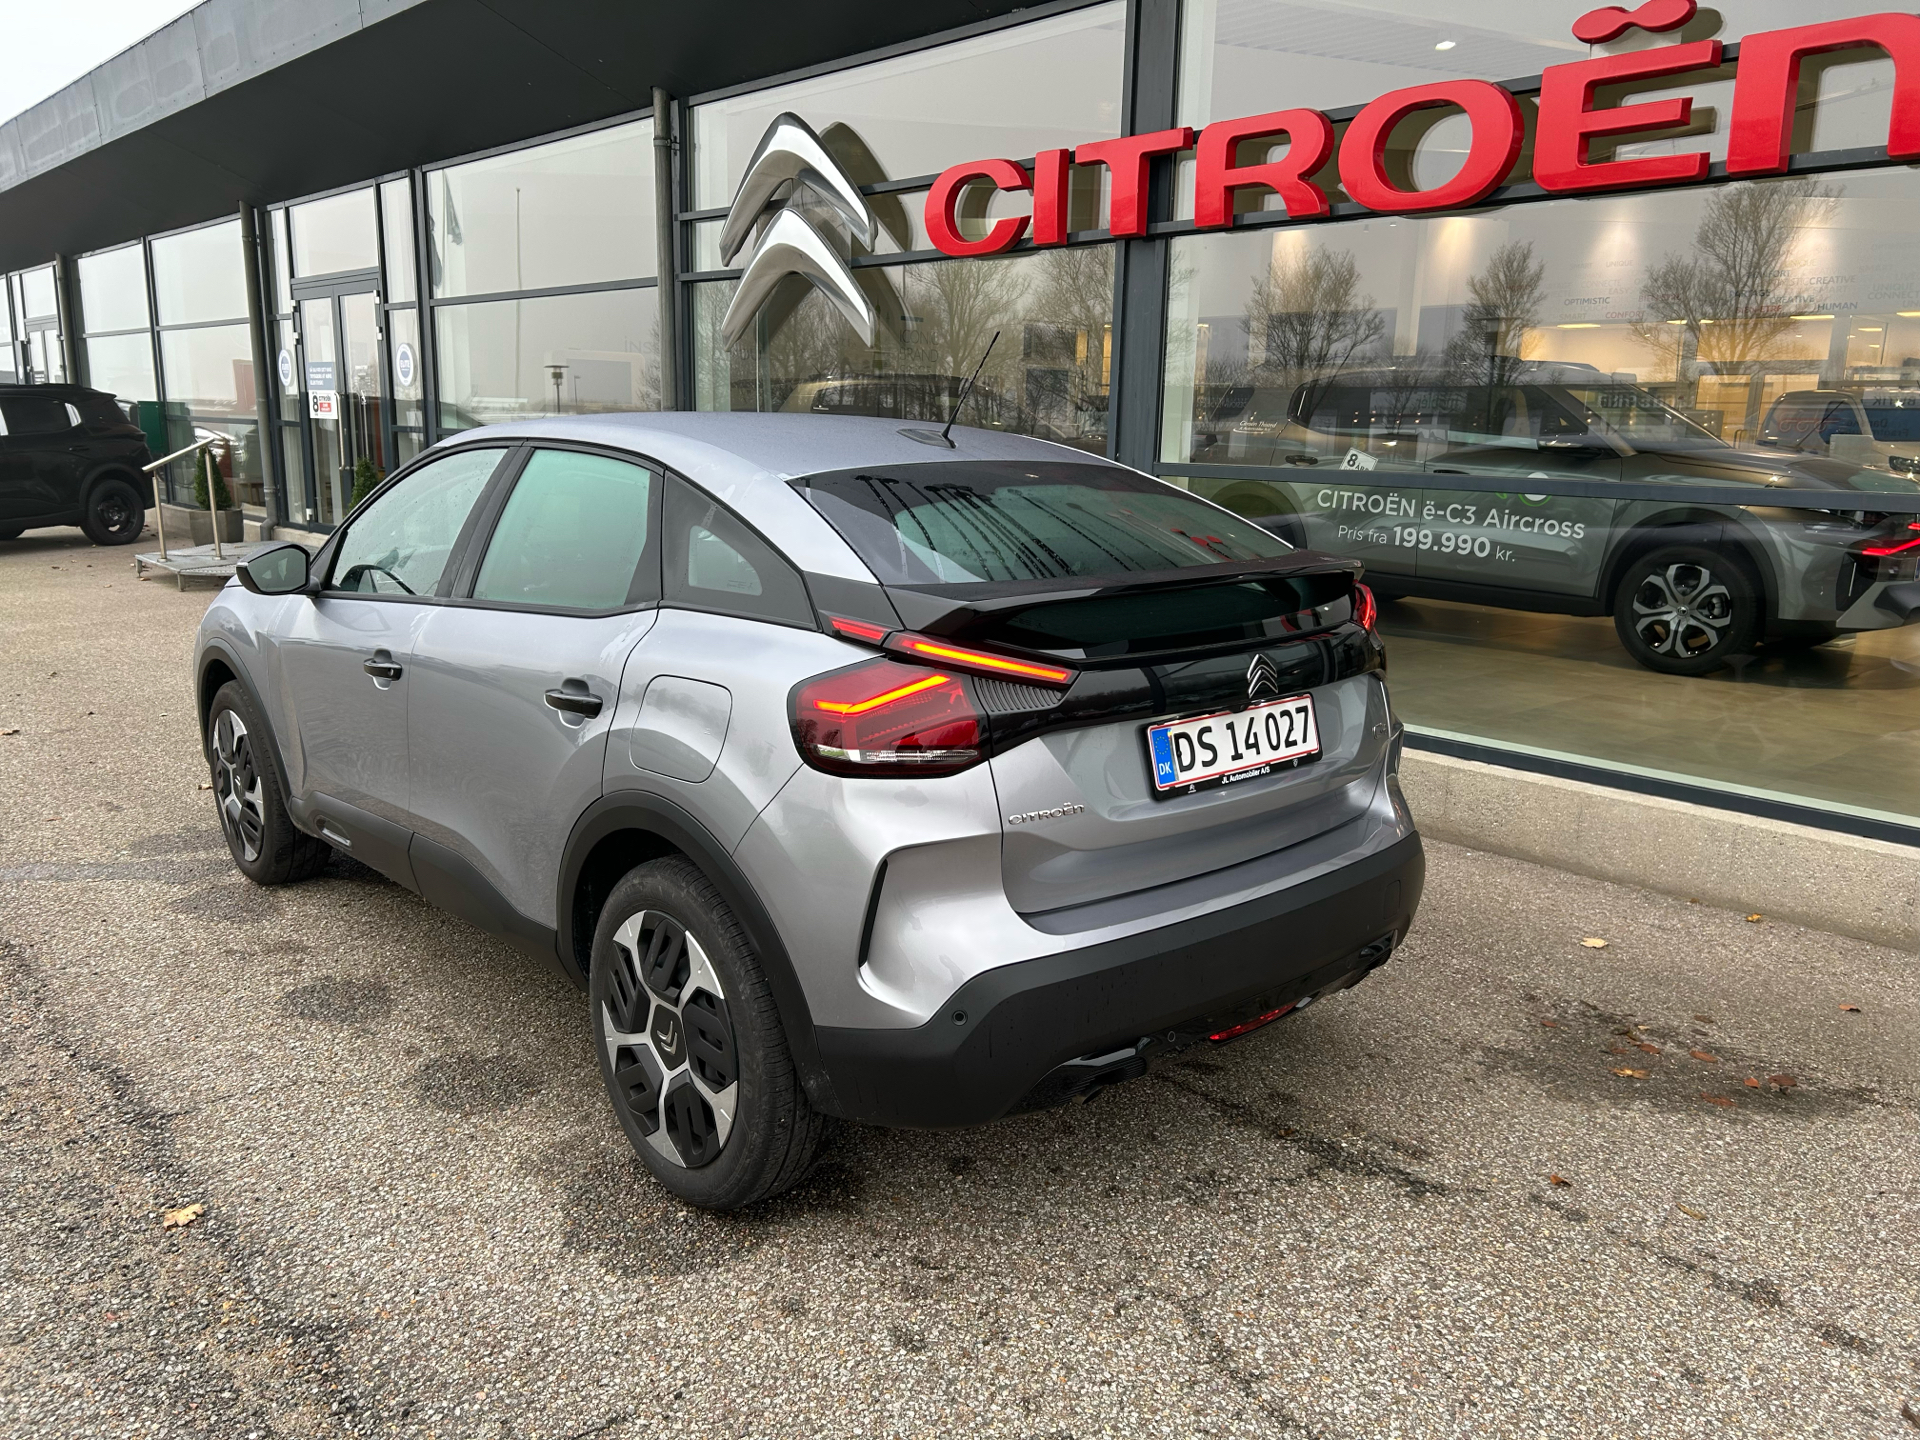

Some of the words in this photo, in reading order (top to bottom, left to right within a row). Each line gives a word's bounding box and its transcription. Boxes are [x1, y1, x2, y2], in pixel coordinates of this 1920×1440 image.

[1605, 260, 1634, 268] UNIQUE
[1809, 275, 1857, 285] CREATIVE
[1872, 282, 1915, 291] UNIQUE
[1563, 296, 1611, 306] OPTIMISTIC
[1770, 294, 1815, 304] CREATIVE
[1817, 302, 1858, 311] HUMAN
[1605, 310, 1646, 319] CONFORT
[900, 329, 939, 346] ICONIC
[899, 347, 939, 363] BRAND
[1347, 453, 1358, 467] 8
[1316, 488, 1416, 518] CITROËN
[1422, 500, 1477, 526] ë-C3
[1482, 507, 1586, 539] Aircross
[1337, 524, 1364, 542] Pris
[1367, 528, 1388, 545] fra
[1393, 525, 1491, 558] 199.990
[1495, 545, 1516, 562] kr.
[1174, 725, 1218, 773] DS
[1225, 716, 1261, 762] 14
[1265, 705, 1309, 752] 027
[1158, 762, 1172, 776] DK
[1221, 776, 1230, 785] JL
[1229, 769, 1260, 783] Automobiler
[1260, 766, 1270, 775] A/S
